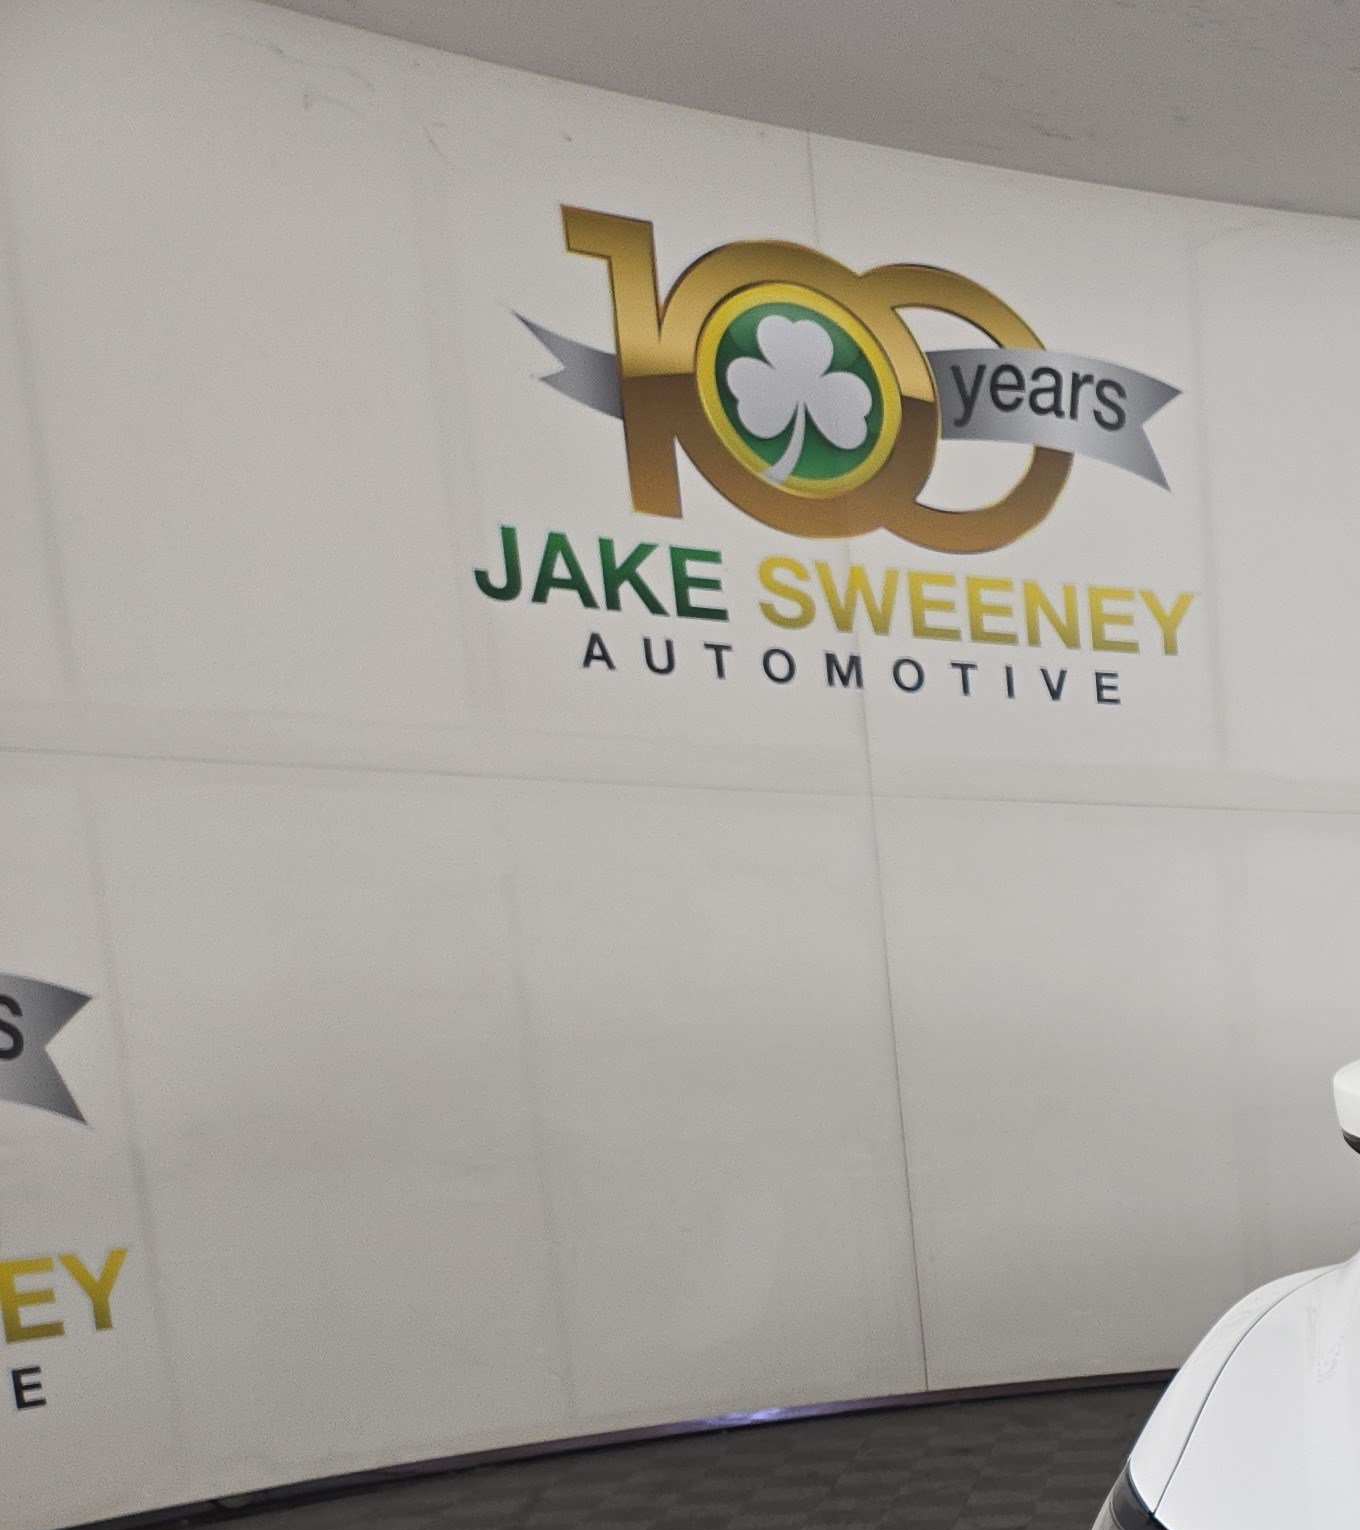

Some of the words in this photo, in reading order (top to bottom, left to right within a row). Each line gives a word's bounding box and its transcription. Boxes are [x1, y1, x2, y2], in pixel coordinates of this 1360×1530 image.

[559, 203, 1074, 554] 100
[950, 361, 1128, 432] years
[474, 525, 729, 622] JAKE
[757, 554, 1196, 655] SWEENEY
[582, 632, 1122, 704] AUTOMOTIVE
